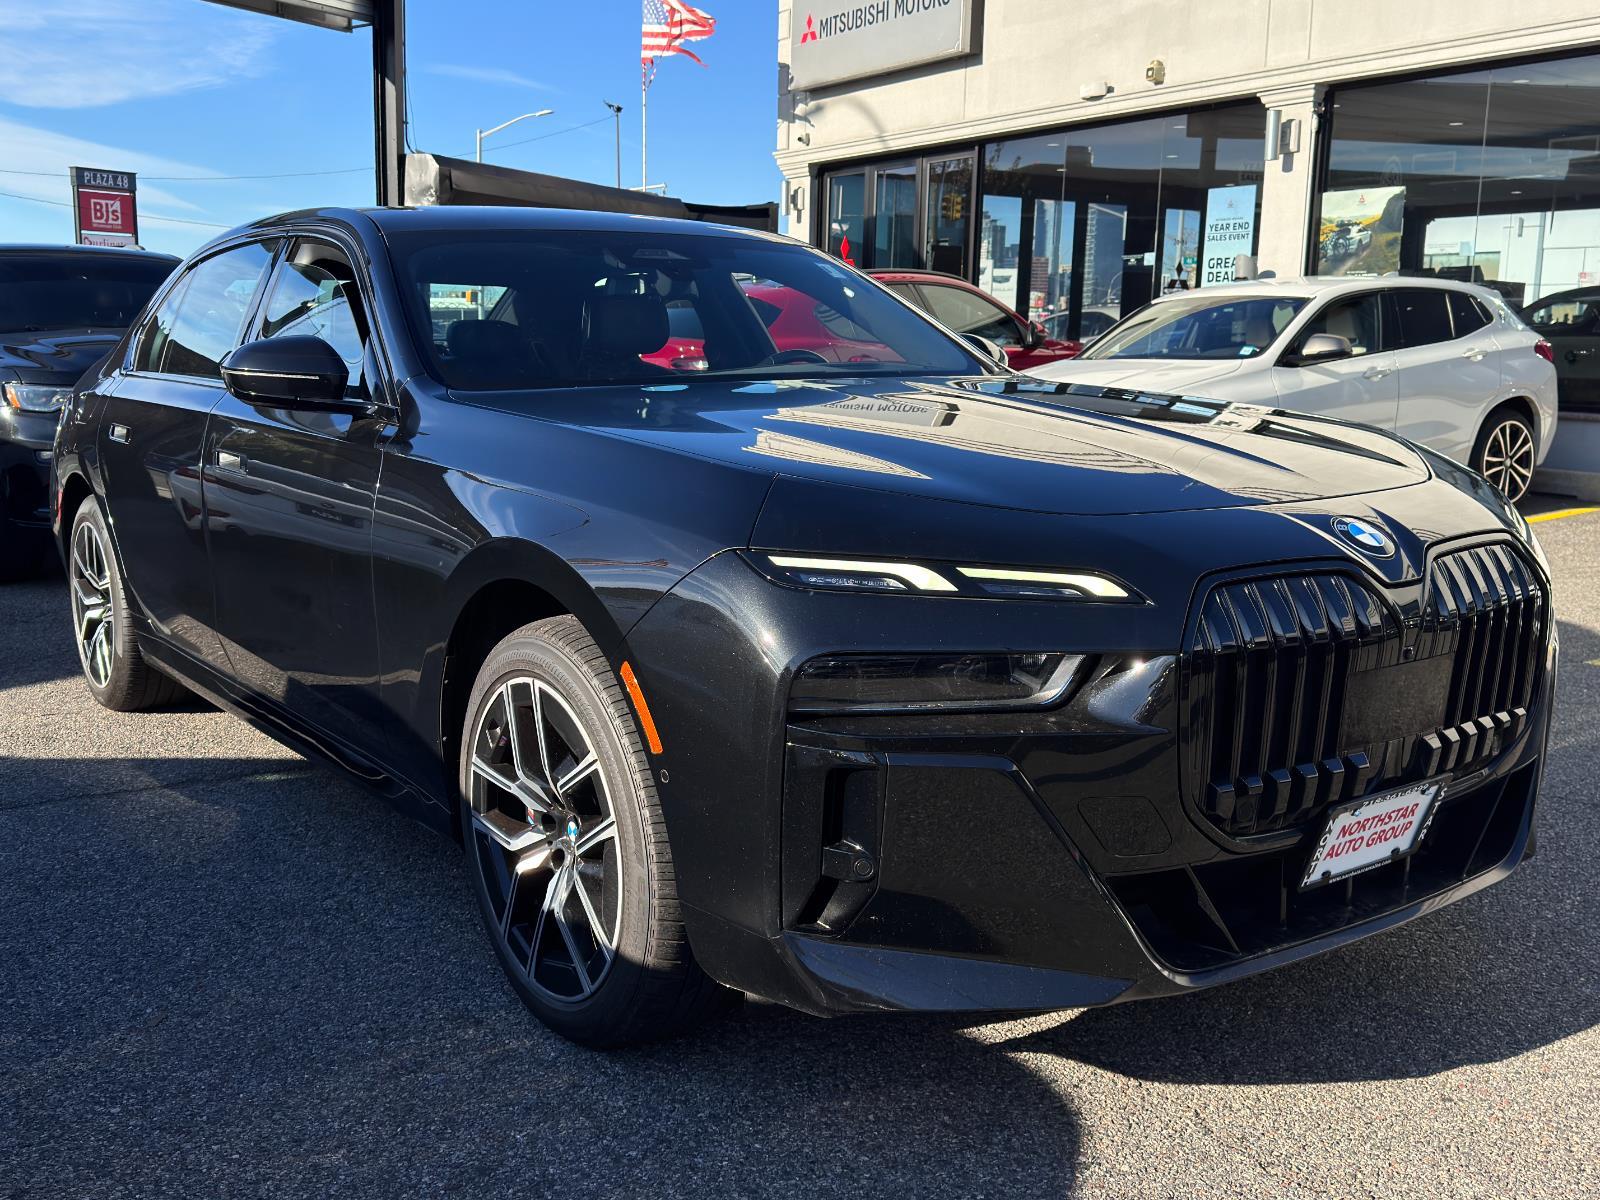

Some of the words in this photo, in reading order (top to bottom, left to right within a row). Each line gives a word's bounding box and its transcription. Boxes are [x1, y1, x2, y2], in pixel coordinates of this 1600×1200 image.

[819, 1, 889, 39] MITSUBISHI
[894, 0, 950, 18] MOTO
[84, 171, 114, 186] PLAZA
[116, 174, 129, 189] 48
[1208, 223, 1231, 232] YEAR
[1232, 221, 1250, 231] END
[1207, 234, 1227, 242] SALES
[1228, 232, 1250, 241] EVENT
[1207, 257, 1236, 270] GREA
[1207, 270, 1236, 283] DEAL
[1335, 802, 1420, 841] NORTHSTAR
[1324, 836, 1364, 861] AUTO
[1366, 820, 1413, 848] GROUP
[1301, 818, 1334, 888] NORTH
